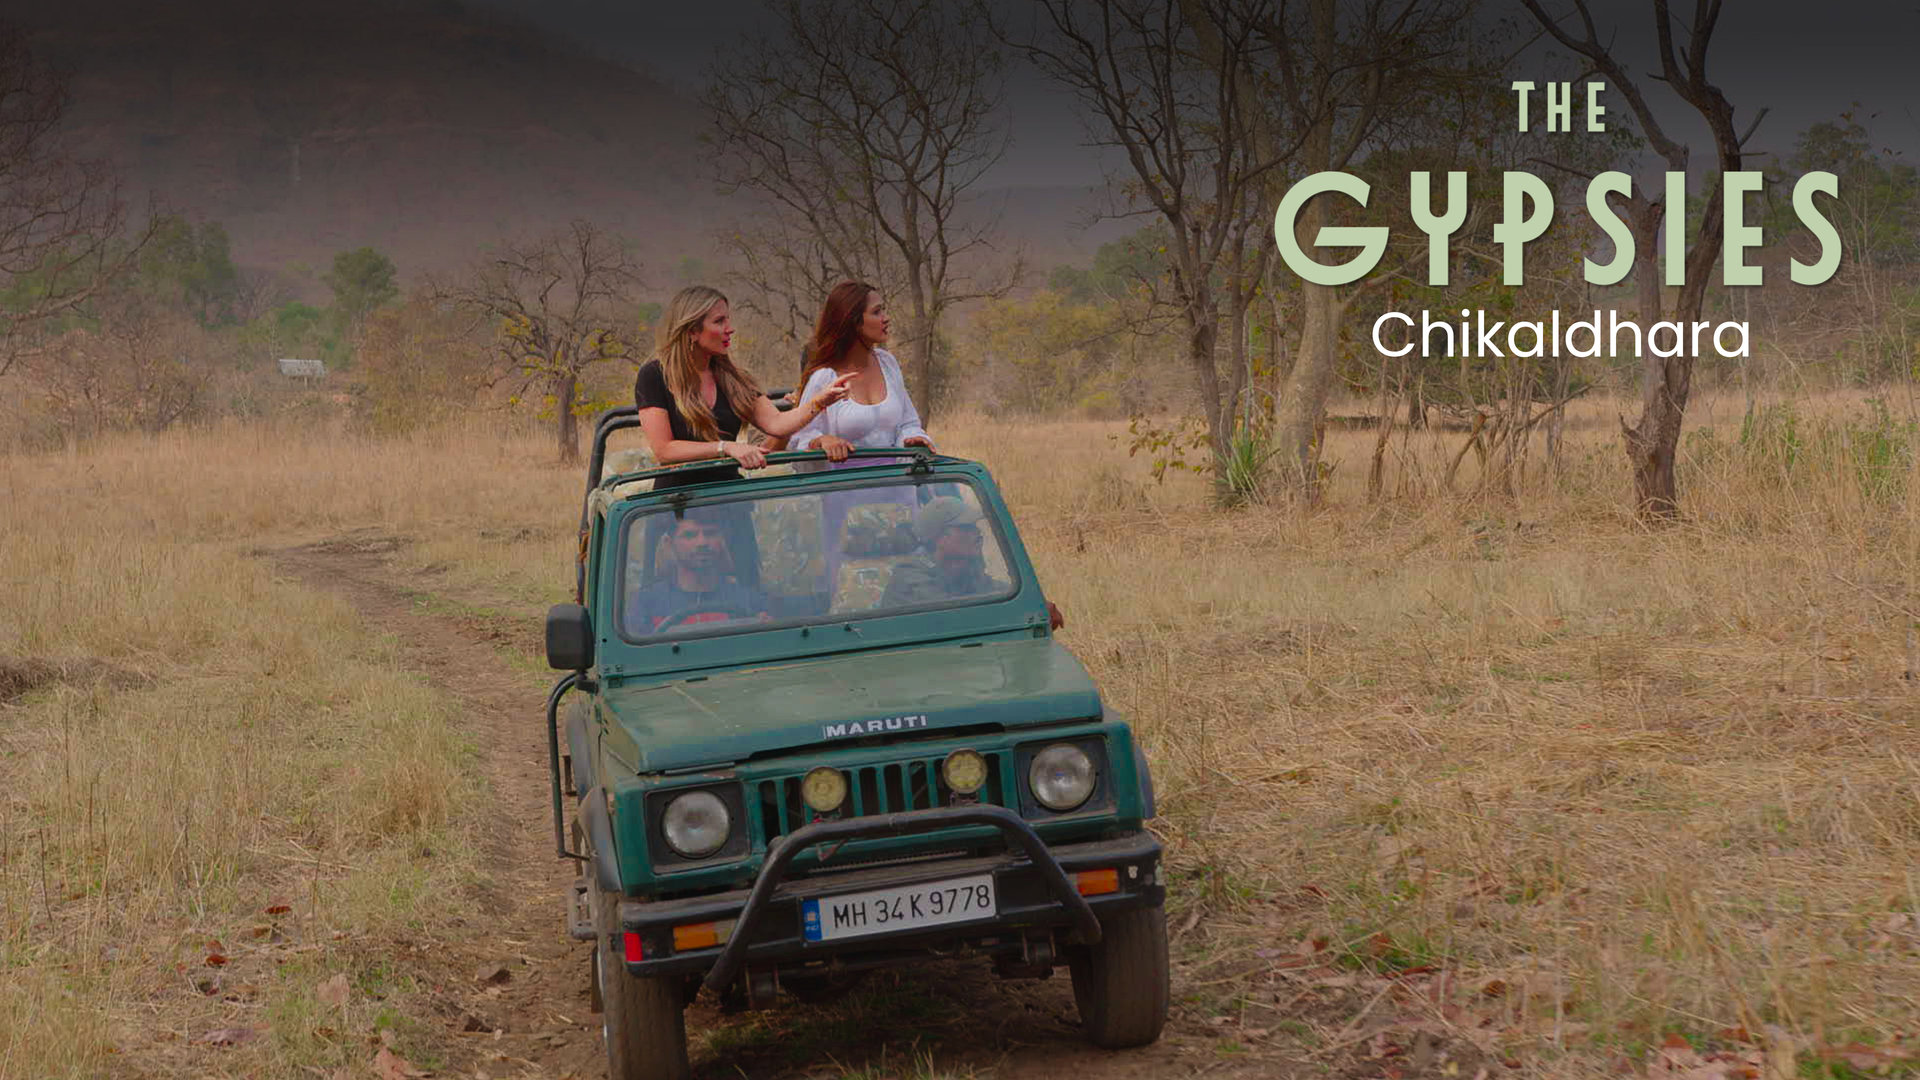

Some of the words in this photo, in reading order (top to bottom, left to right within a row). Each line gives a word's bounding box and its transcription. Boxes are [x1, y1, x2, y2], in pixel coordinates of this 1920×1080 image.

[826, 715, 928, 738] MARUTI
[833, 902, 867, 929] MH
[874, 897, 905, 924] 34
[909, 893, 925, 919] K
[929, 884, 991, 916] 9778
